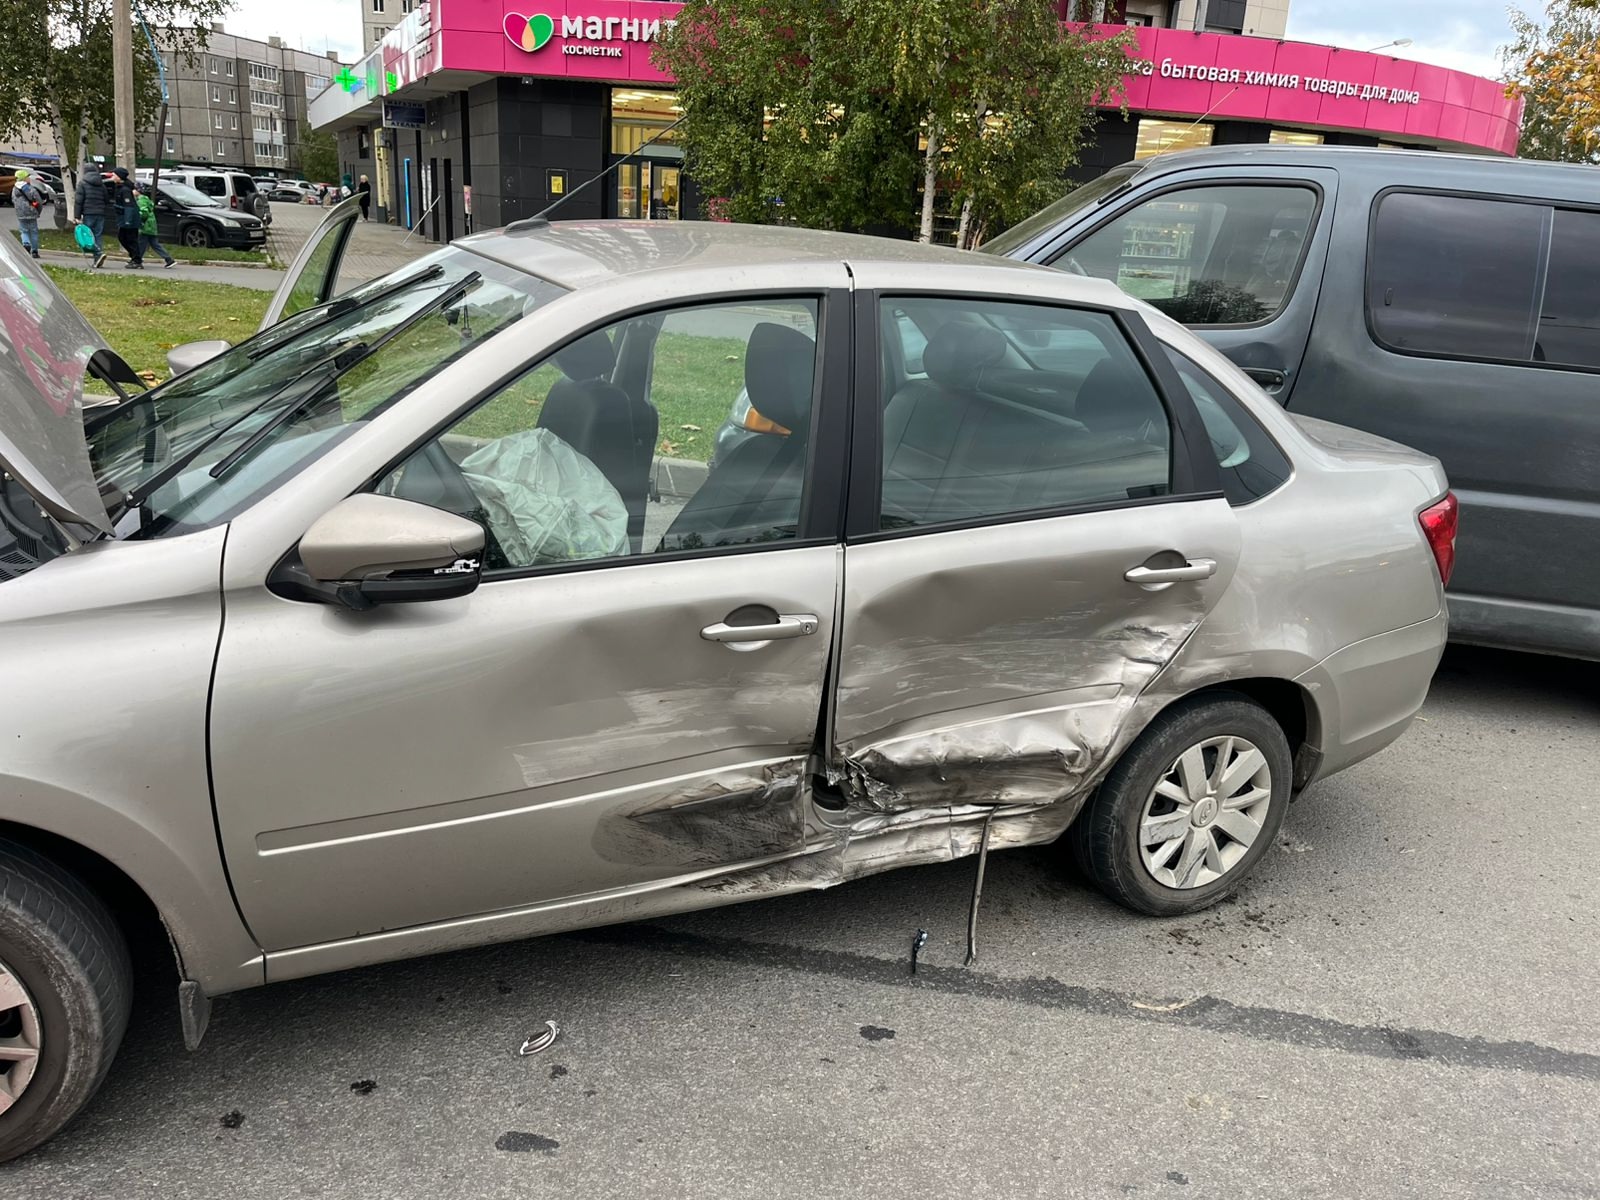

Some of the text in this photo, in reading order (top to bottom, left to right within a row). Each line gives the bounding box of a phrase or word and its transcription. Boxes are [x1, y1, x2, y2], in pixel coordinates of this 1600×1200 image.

[561, 44, 622, 57] косметик
[1160, 58, 1240, 83] бытовая
[1244, 70, 1299, 89] химия
[1303, 76, 1358, 98] товары
[1360, 84, 1387, 101] для
[1388, 88, 1420, 105] дома
